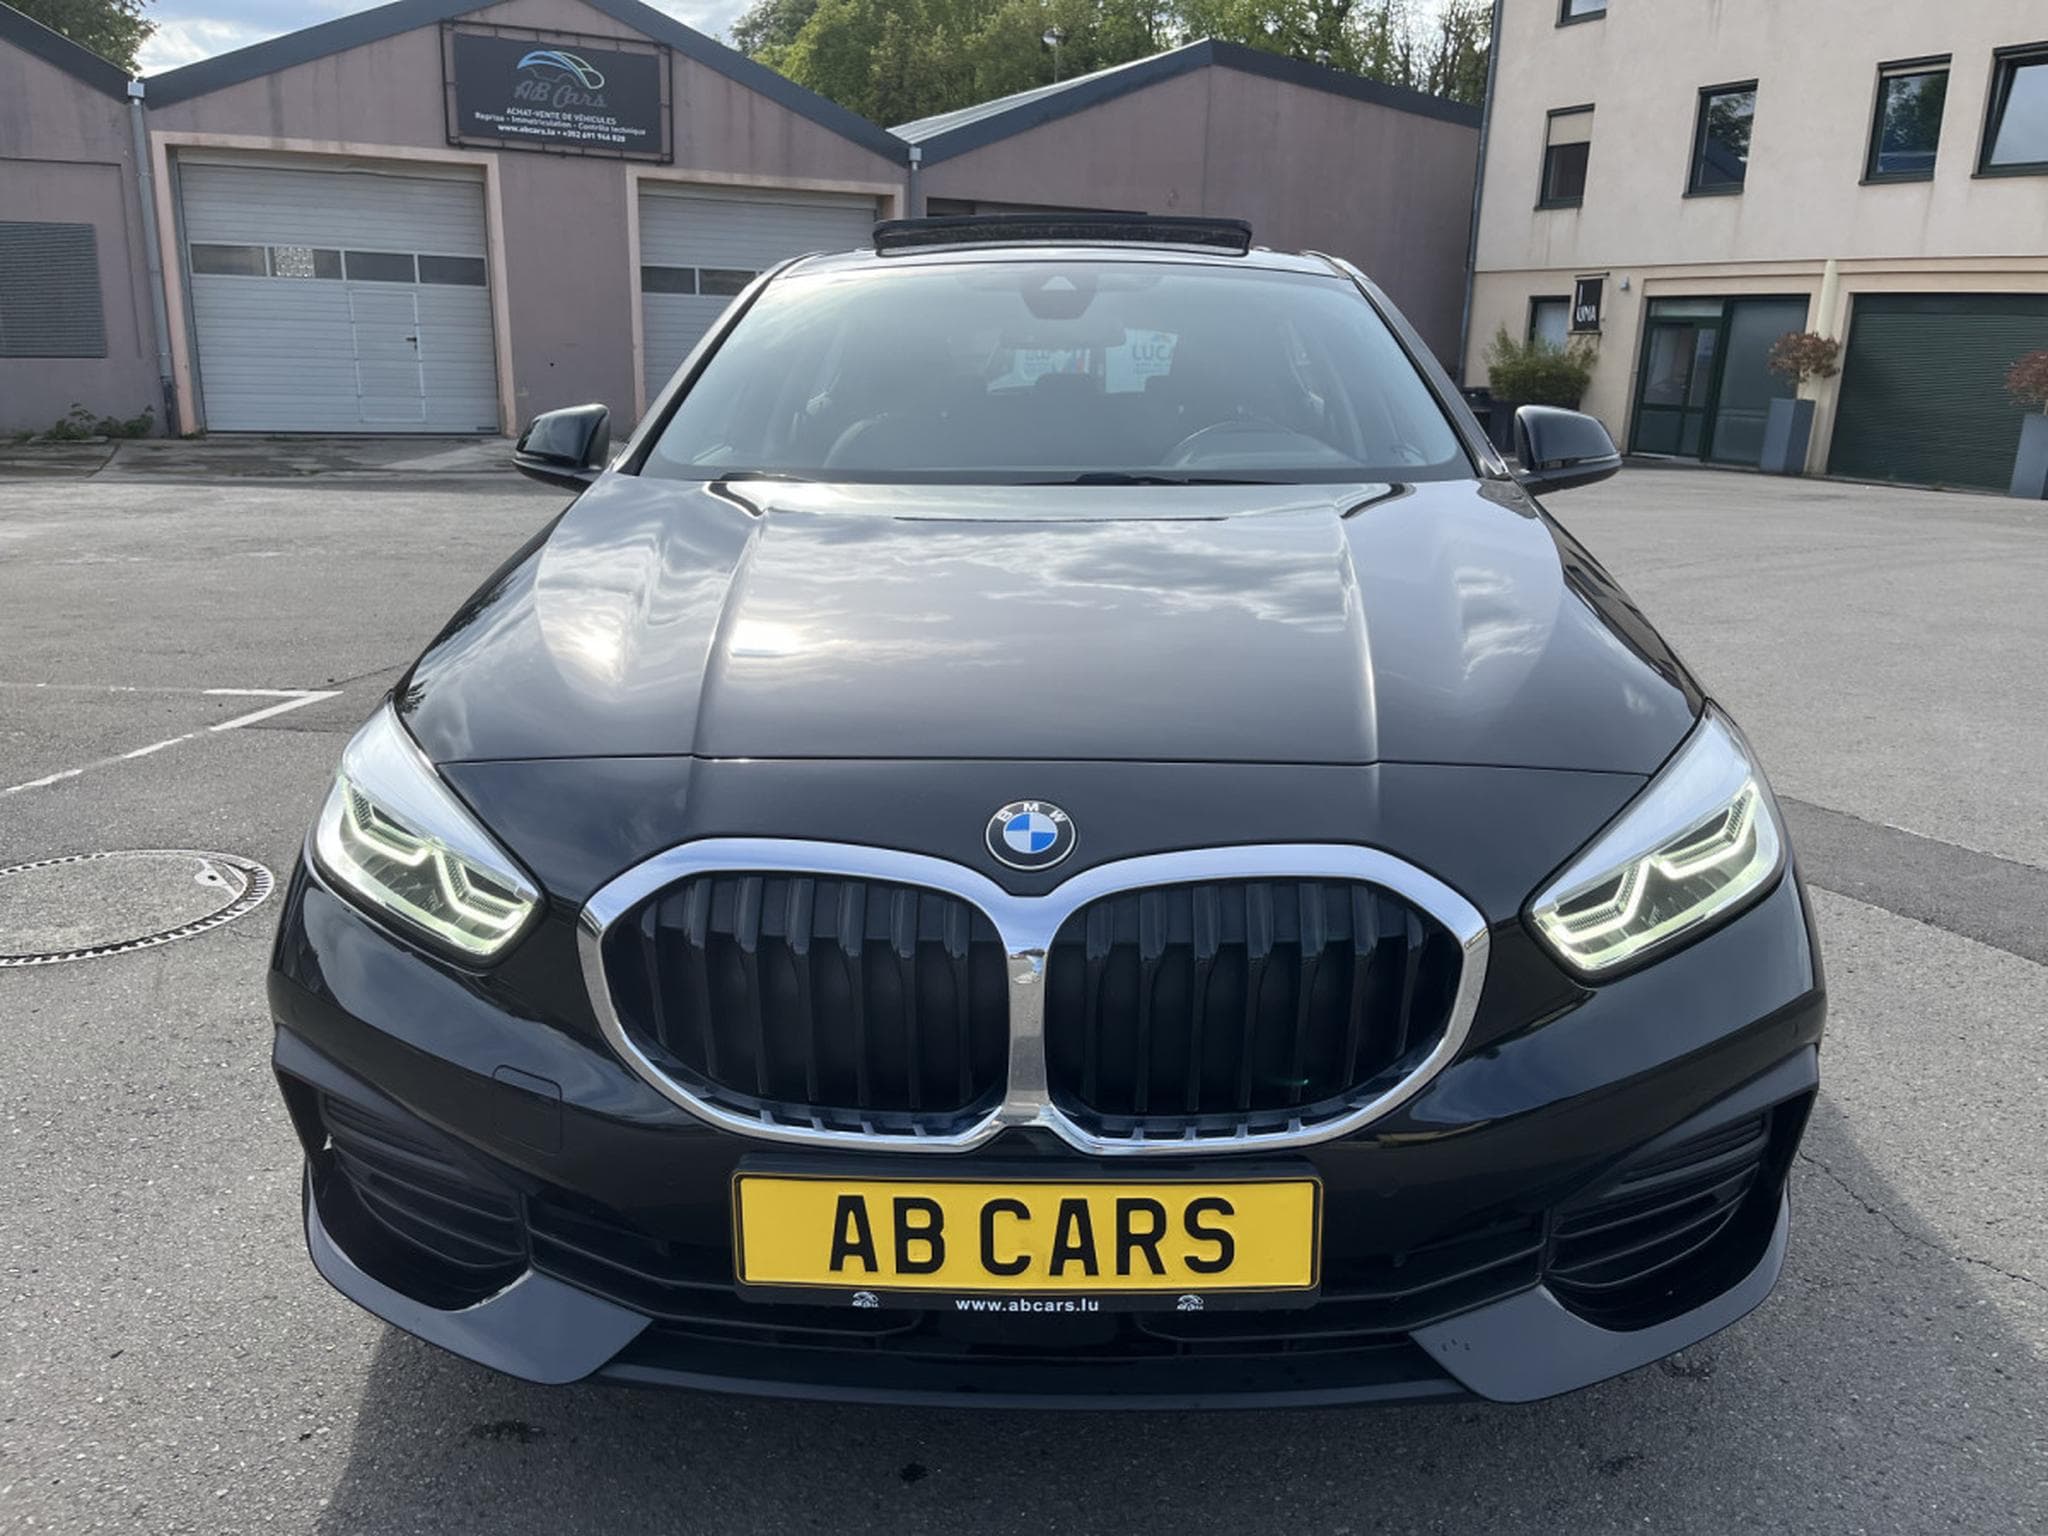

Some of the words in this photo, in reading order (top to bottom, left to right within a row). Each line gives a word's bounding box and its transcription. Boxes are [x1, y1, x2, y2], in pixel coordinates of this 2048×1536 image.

[474, 112, 505, 122] Reprise
[506, 107, 560, 120] ACHAT-VENTE
[561, 113, 572, 121] DE
[996, 802, 1067, 822] BMW
[829, 1194, 946, 1275] AB
[979, 1196, 1235, 1277] CARS
[955, 1298, 1099, 1312] www.abcars.lu
